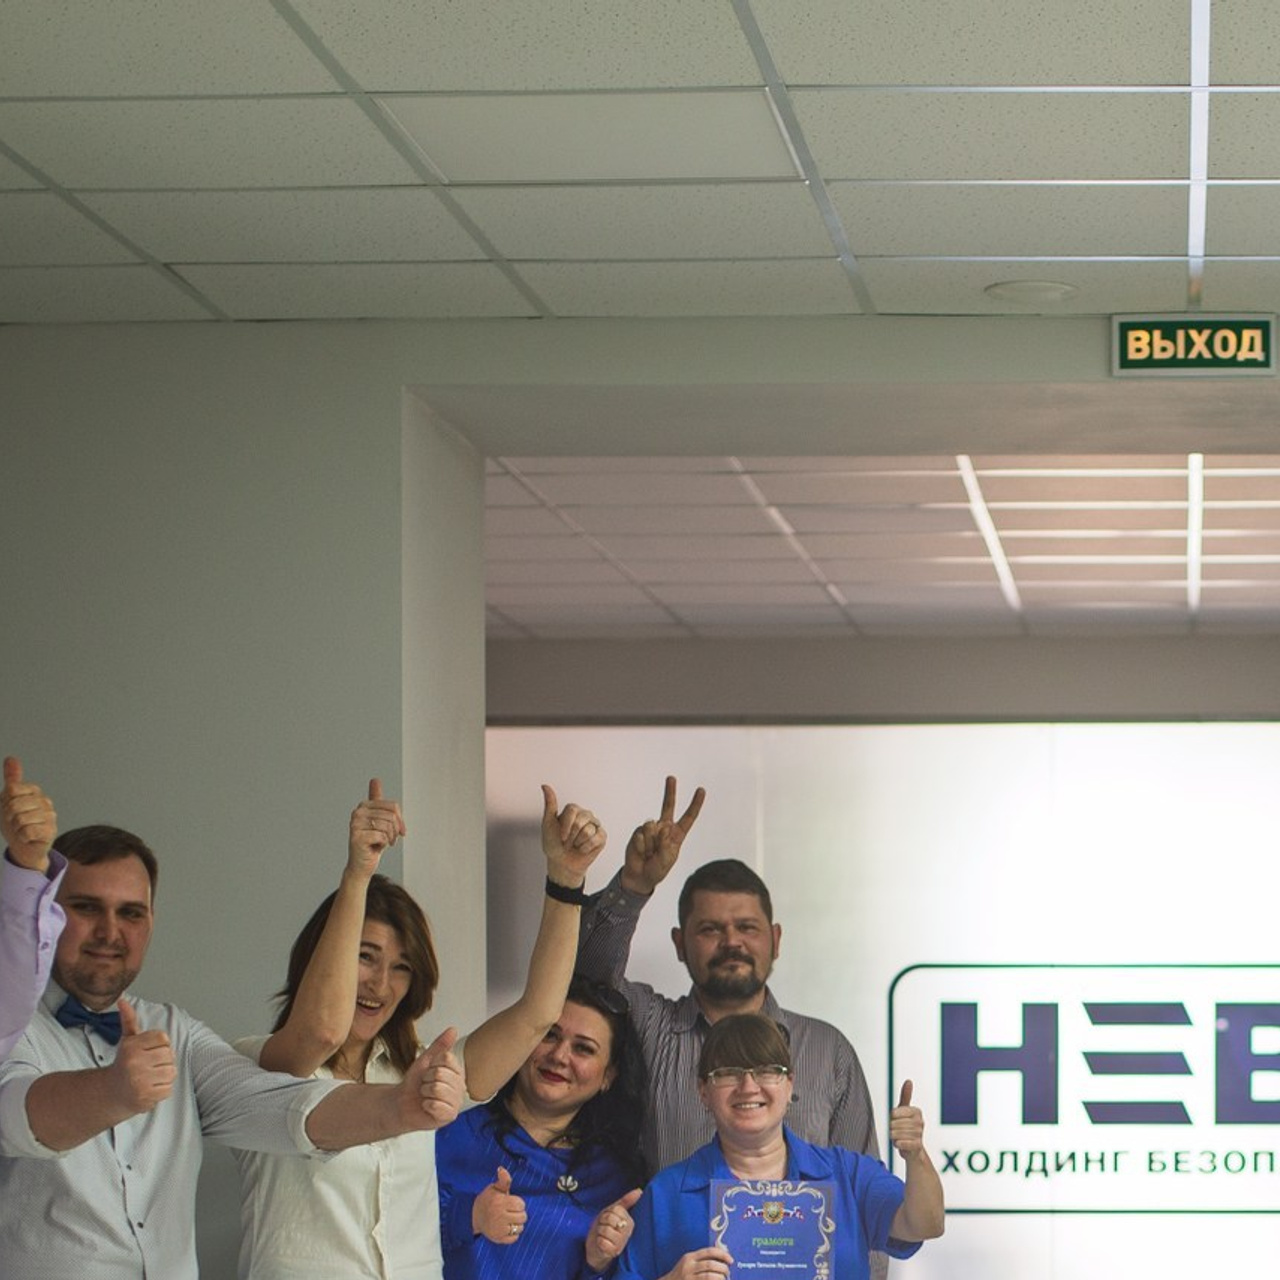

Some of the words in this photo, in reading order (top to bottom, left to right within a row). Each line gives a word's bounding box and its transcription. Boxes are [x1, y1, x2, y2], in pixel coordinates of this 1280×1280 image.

[1126, 329, 1265, 361] ВЫХОД
[941, 1149, 1130, 1178] ХОЛДИНГ
[752, 1237, 794, 1248] грамота
